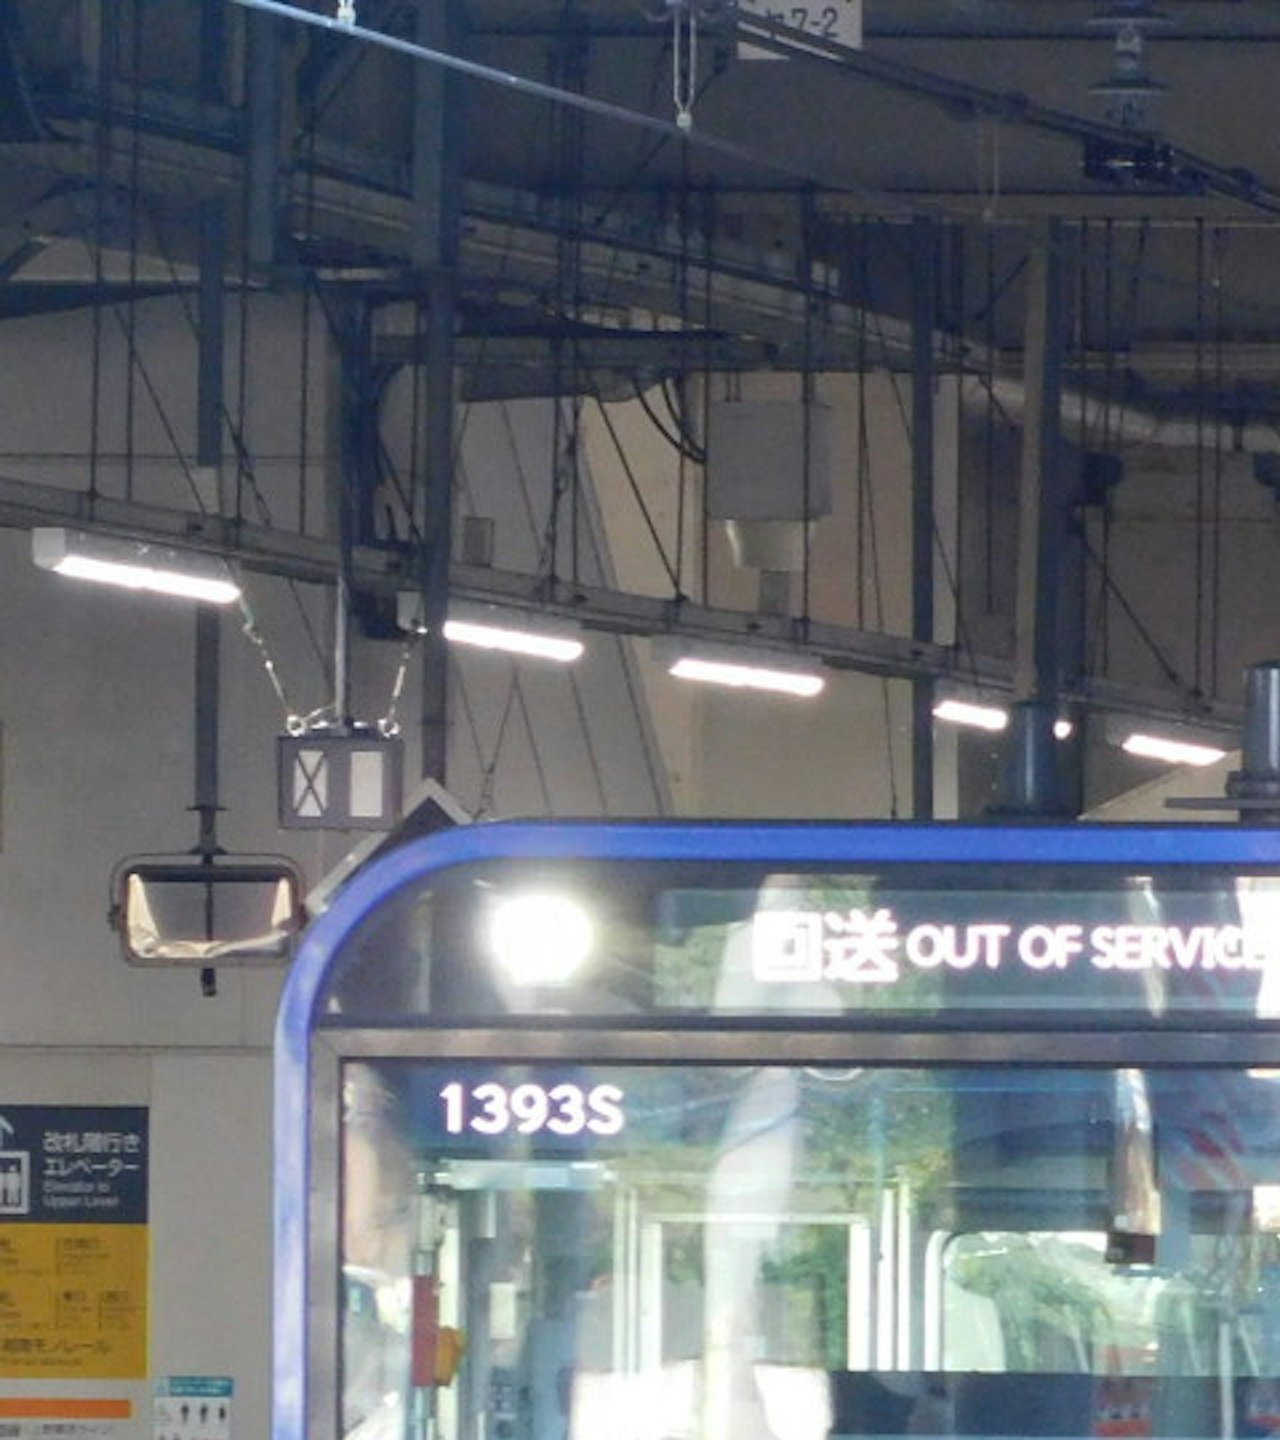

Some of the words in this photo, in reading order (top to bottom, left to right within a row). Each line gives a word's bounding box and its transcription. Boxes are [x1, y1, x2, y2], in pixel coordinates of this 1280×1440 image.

[753, 908, 898, 982] 回送
[906, 924, 1009, 970] OUT
[1018, 924, 1082, 970] OF
[440, 1082, 625, 1135] 1393S
[43, 1157, 140, 1178] エレベーター
